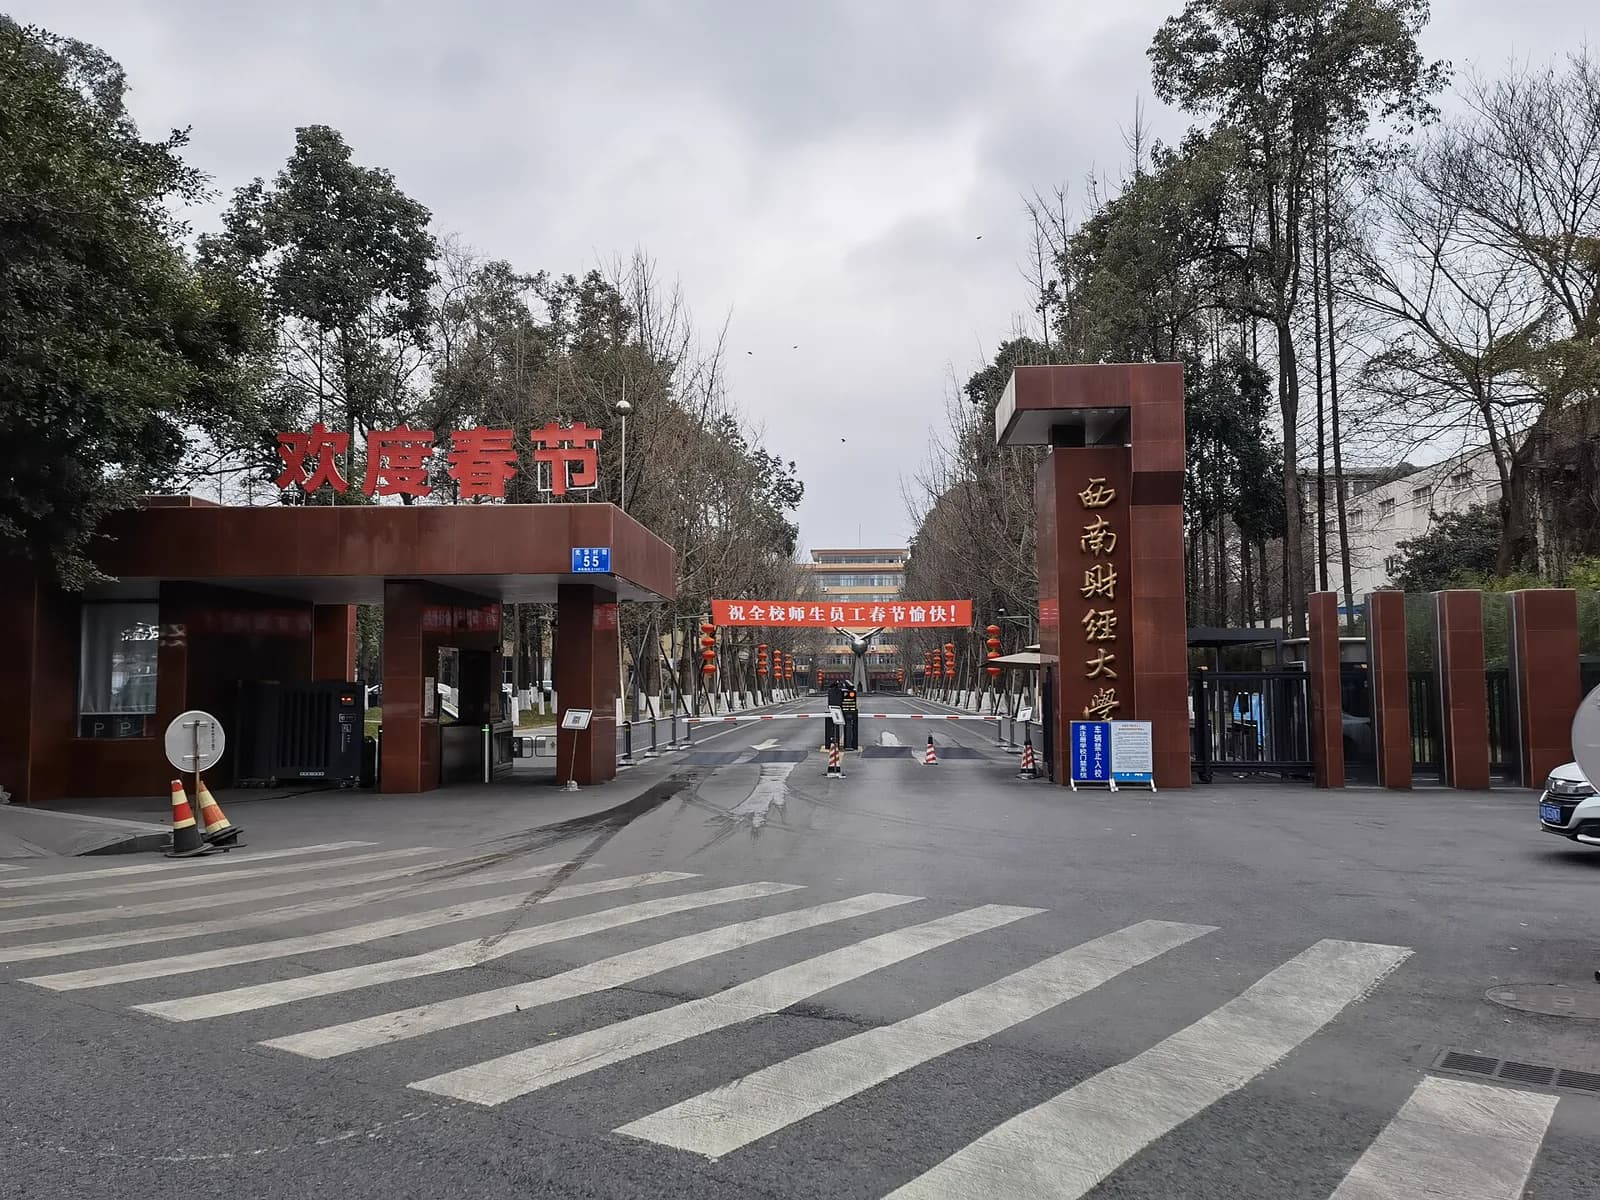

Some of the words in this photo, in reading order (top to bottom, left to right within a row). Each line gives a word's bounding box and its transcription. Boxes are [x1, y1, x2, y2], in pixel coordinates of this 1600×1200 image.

[277, 422, 602, 498] 欢度春节
[583, 556, 599, 567] 55
[1094, 725, 1102, 778] 车辆禁止入校
